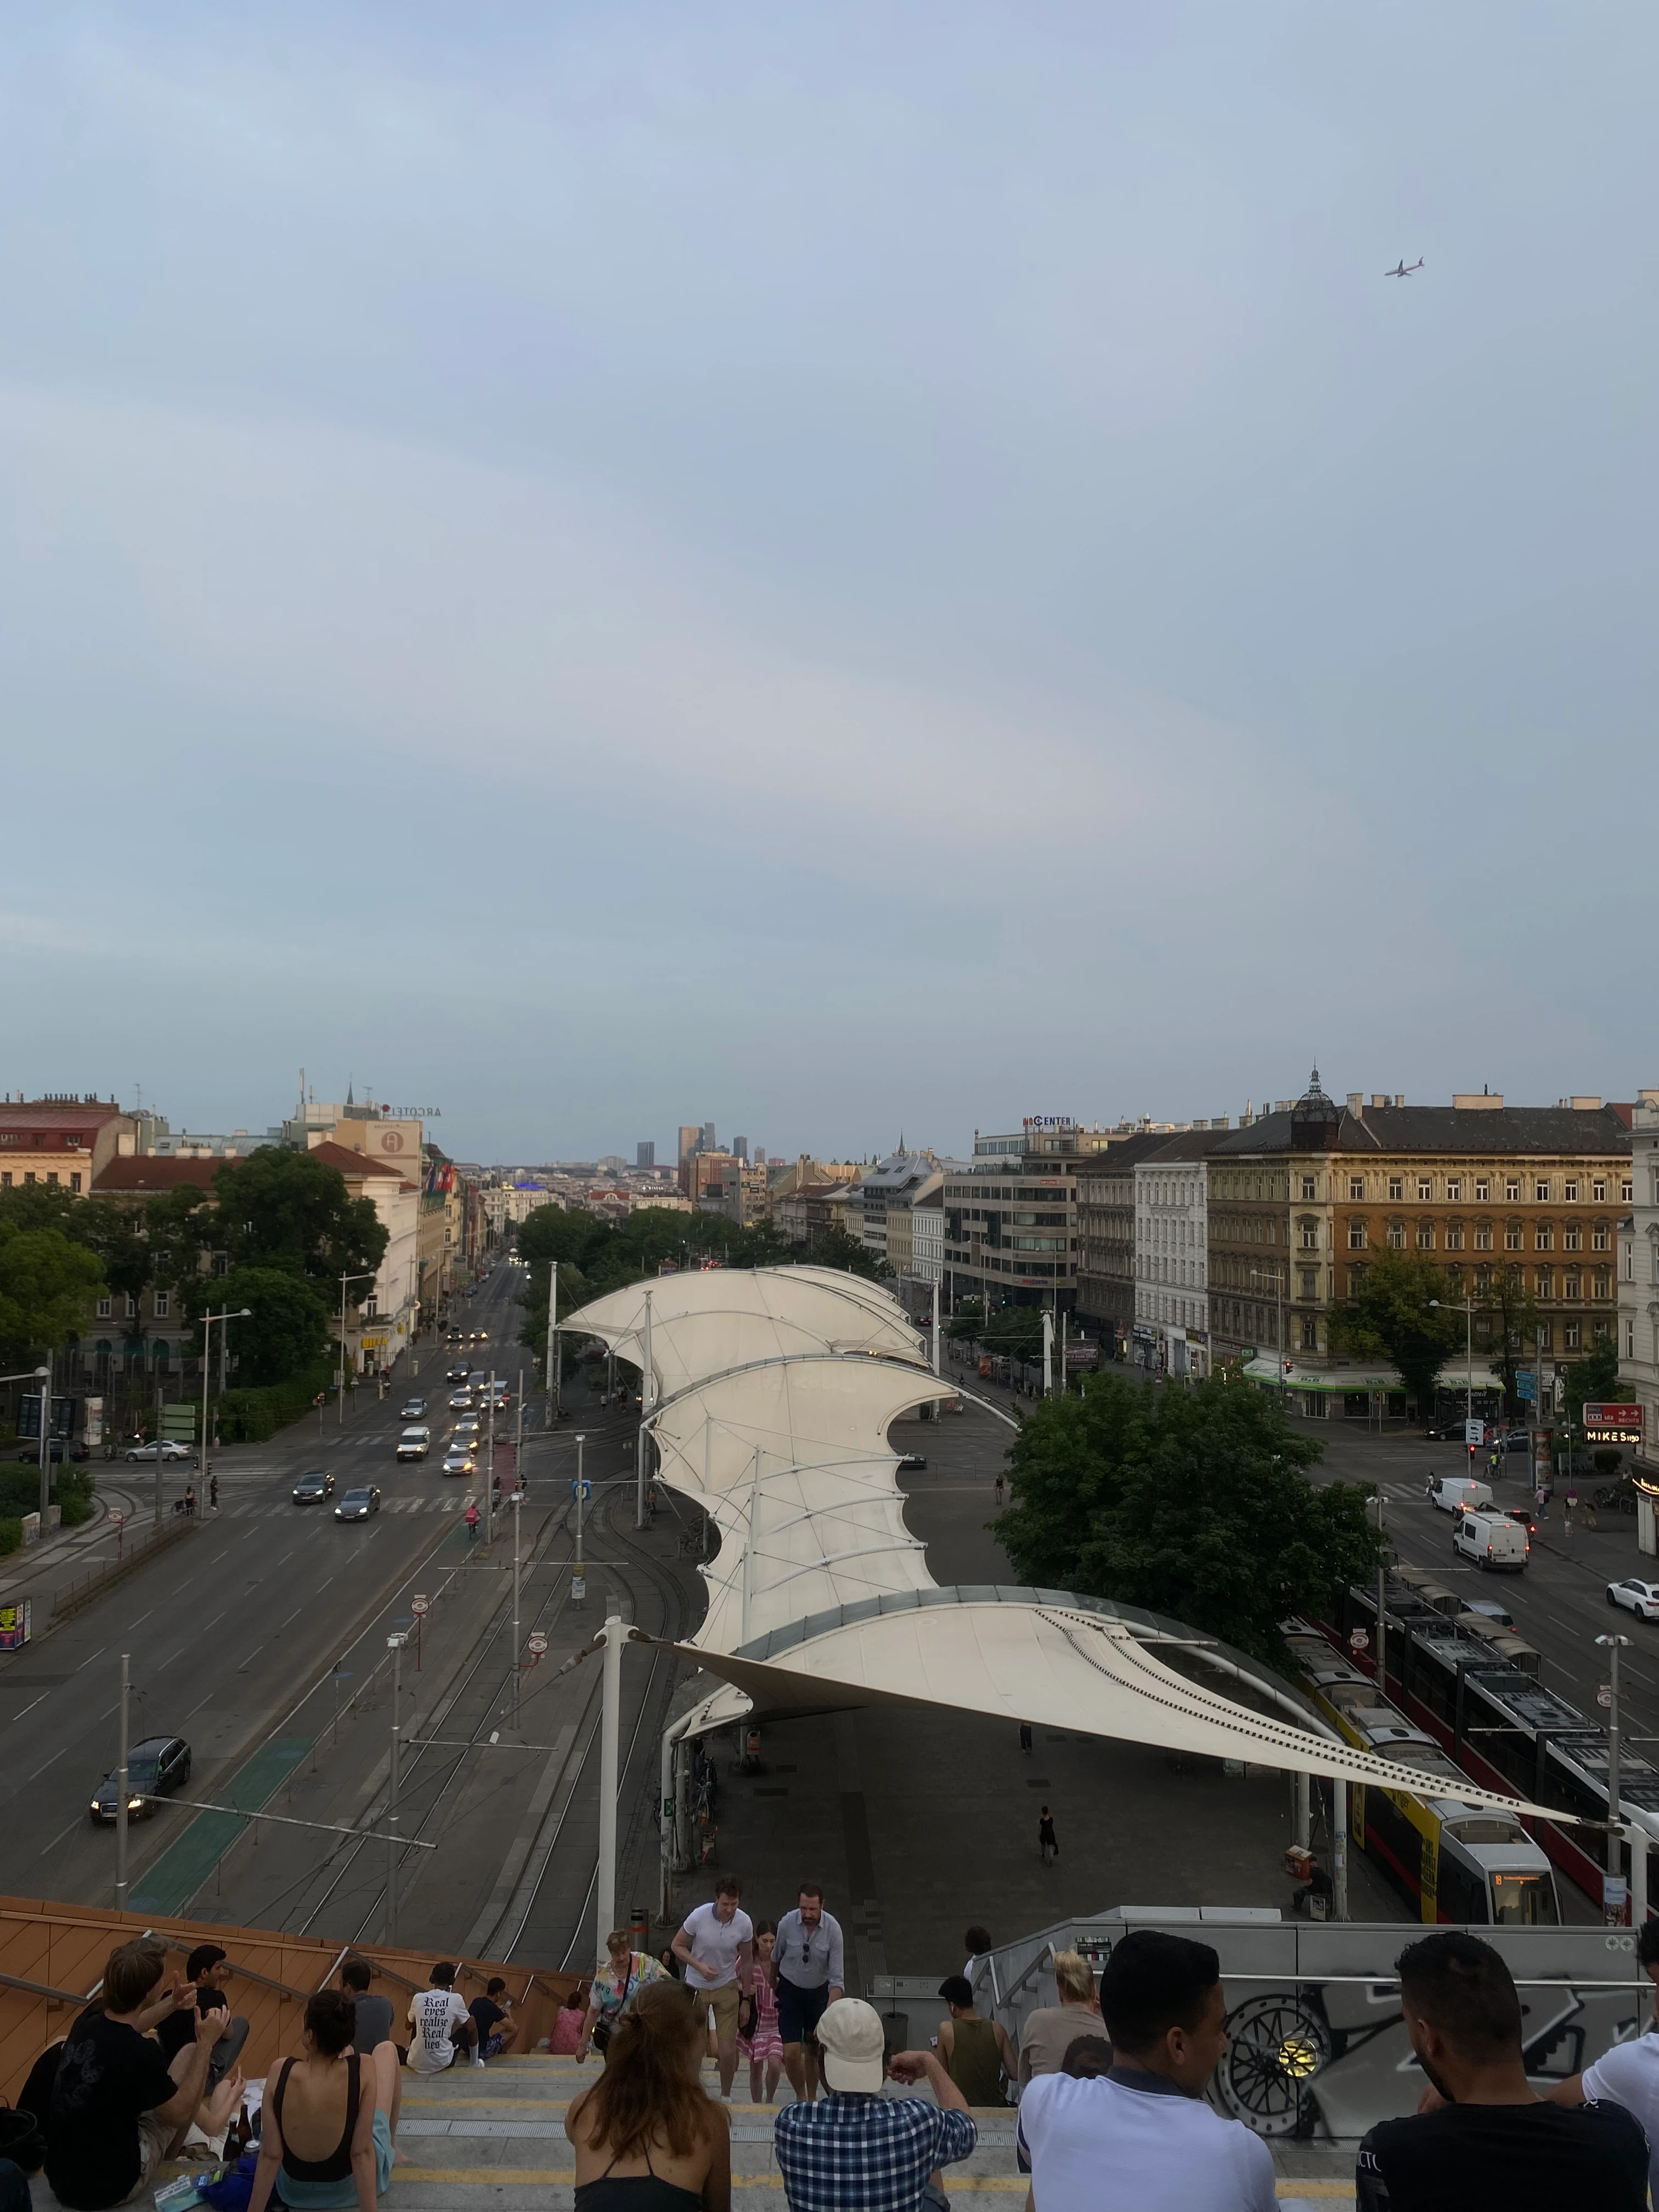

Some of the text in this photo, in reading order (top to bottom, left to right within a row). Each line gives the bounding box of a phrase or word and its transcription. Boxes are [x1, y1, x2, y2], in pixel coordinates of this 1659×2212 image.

[423, 1997, 449, 2007] Real
[425, 2007, 447, 2018] eyes
[420, 2016, 448, 2027] realize
[422, 2027, 444, 2038] Real
[425, 2038, 441, 2049] lies
